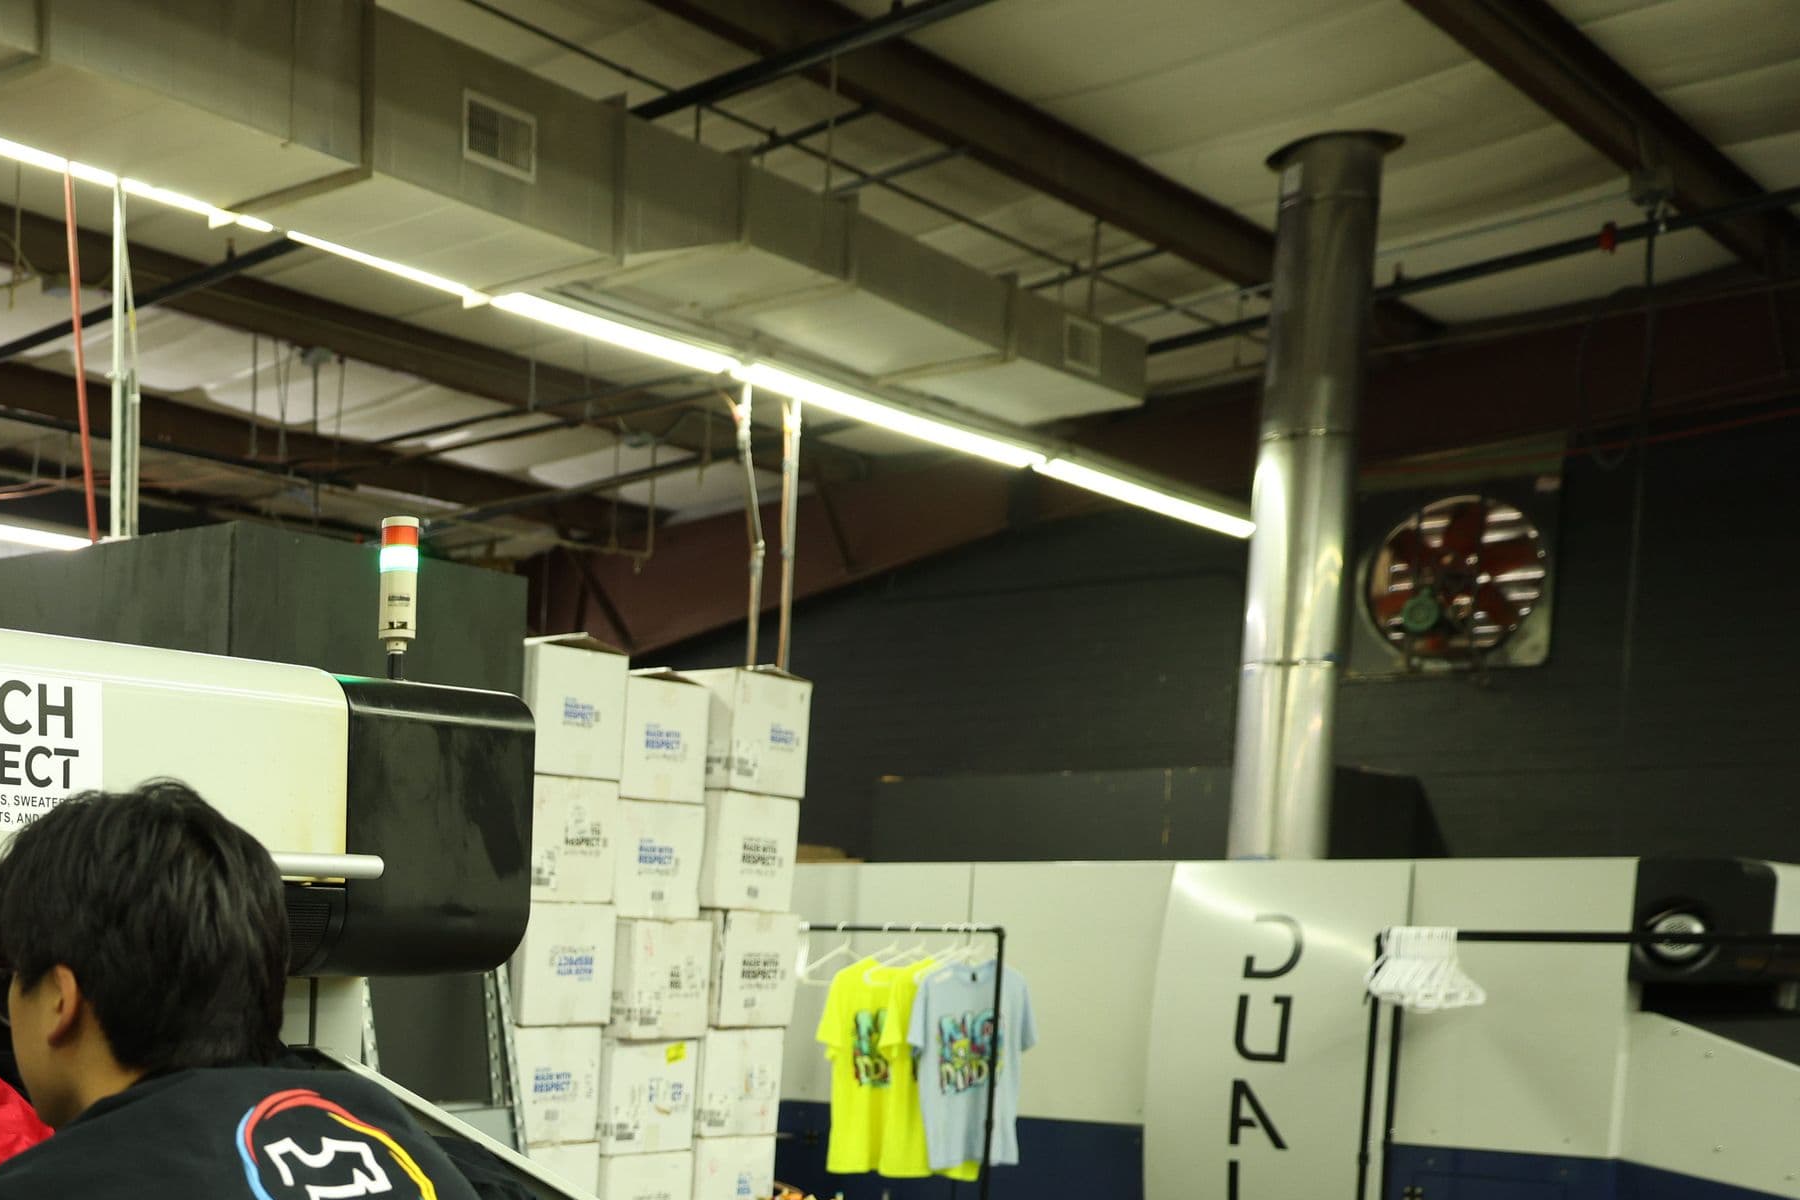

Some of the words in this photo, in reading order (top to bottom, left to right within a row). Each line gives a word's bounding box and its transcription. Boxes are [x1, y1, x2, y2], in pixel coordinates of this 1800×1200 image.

[645, 739, 680, 750] RESPECT
[16, 813, 40, 825] AND
[638, 854, 673, 865] RESPECT
[742, 853, 776, 866] RESPECT
[741, 968, 777, 979] RESPECT
[533, 1080, 571, 1093] RESPECT
